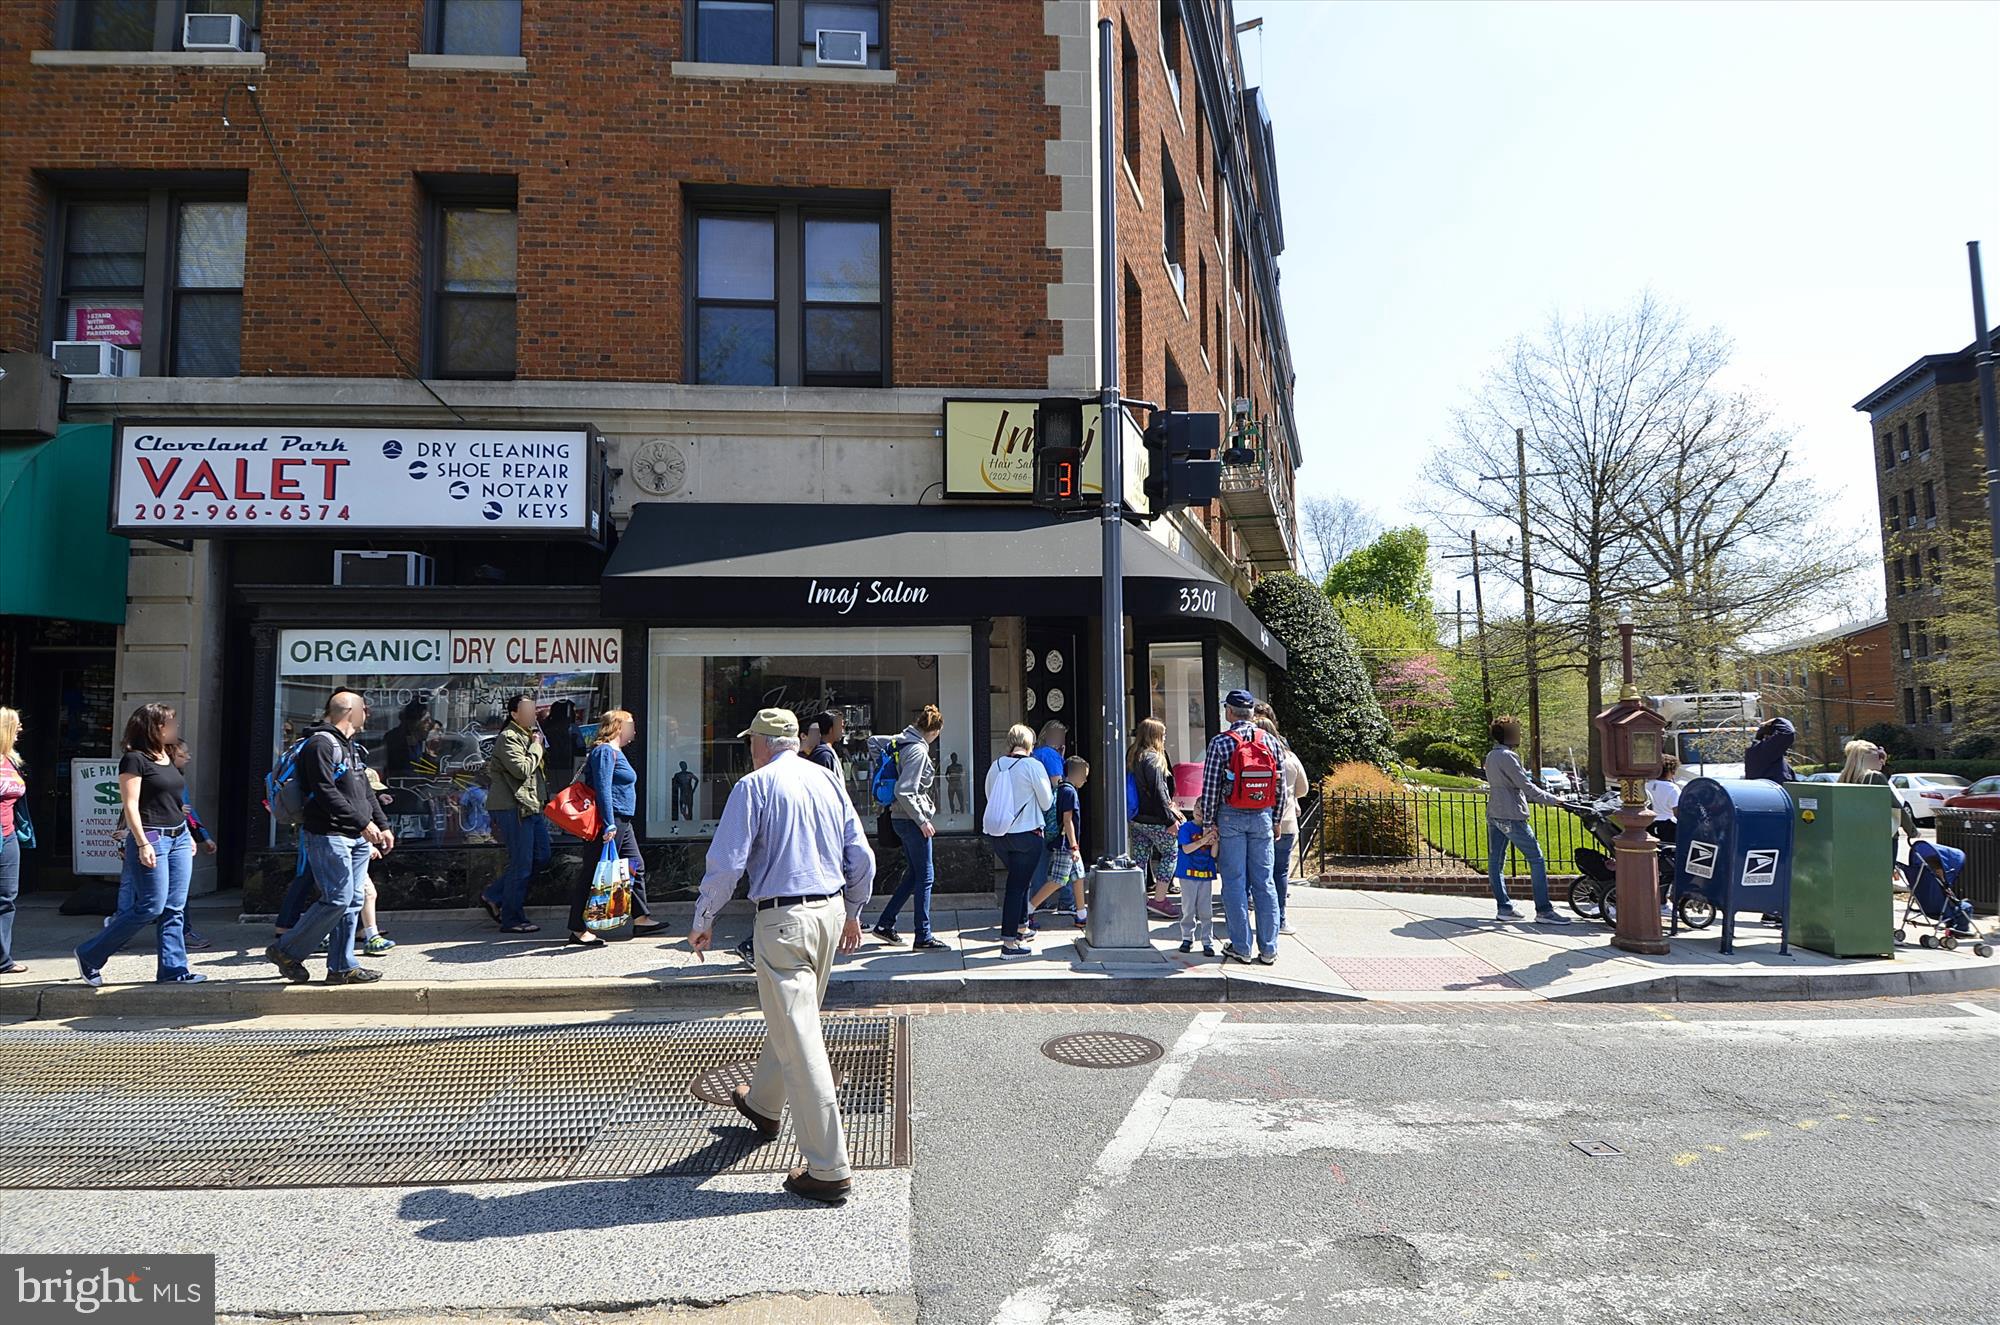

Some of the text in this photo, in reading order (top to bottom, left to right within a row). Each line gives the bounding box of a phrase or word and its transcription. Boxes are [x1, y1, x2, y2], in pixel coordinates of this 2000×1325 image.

[134, 435, 349, 451] Cleveland Park
[991, 409, 1099, 463] Imj
[418, 442, 569, 458] DRY CLEANING
[437, 463, 568, 478] SHOE REPAIR
[989, 458, 1034, 469] Hair Sal
[136, 457, 350, 500] VALET
[1059, 462, 1071, 496] 3
[482, 483, 568, 498] NOTARY
[135, 504, 350, 520] 202-966-6574
[518, 503, 568, 518] KEYS
[807, 580, 929, 614] Imaj Salon
[1179, 587, 1217, 612] 3301
[290, 639, 441, 663] ORGANIC!
[453, 637, 618, 664] DRY CLEANING
[81, 766, 118, 779] WE PAY
